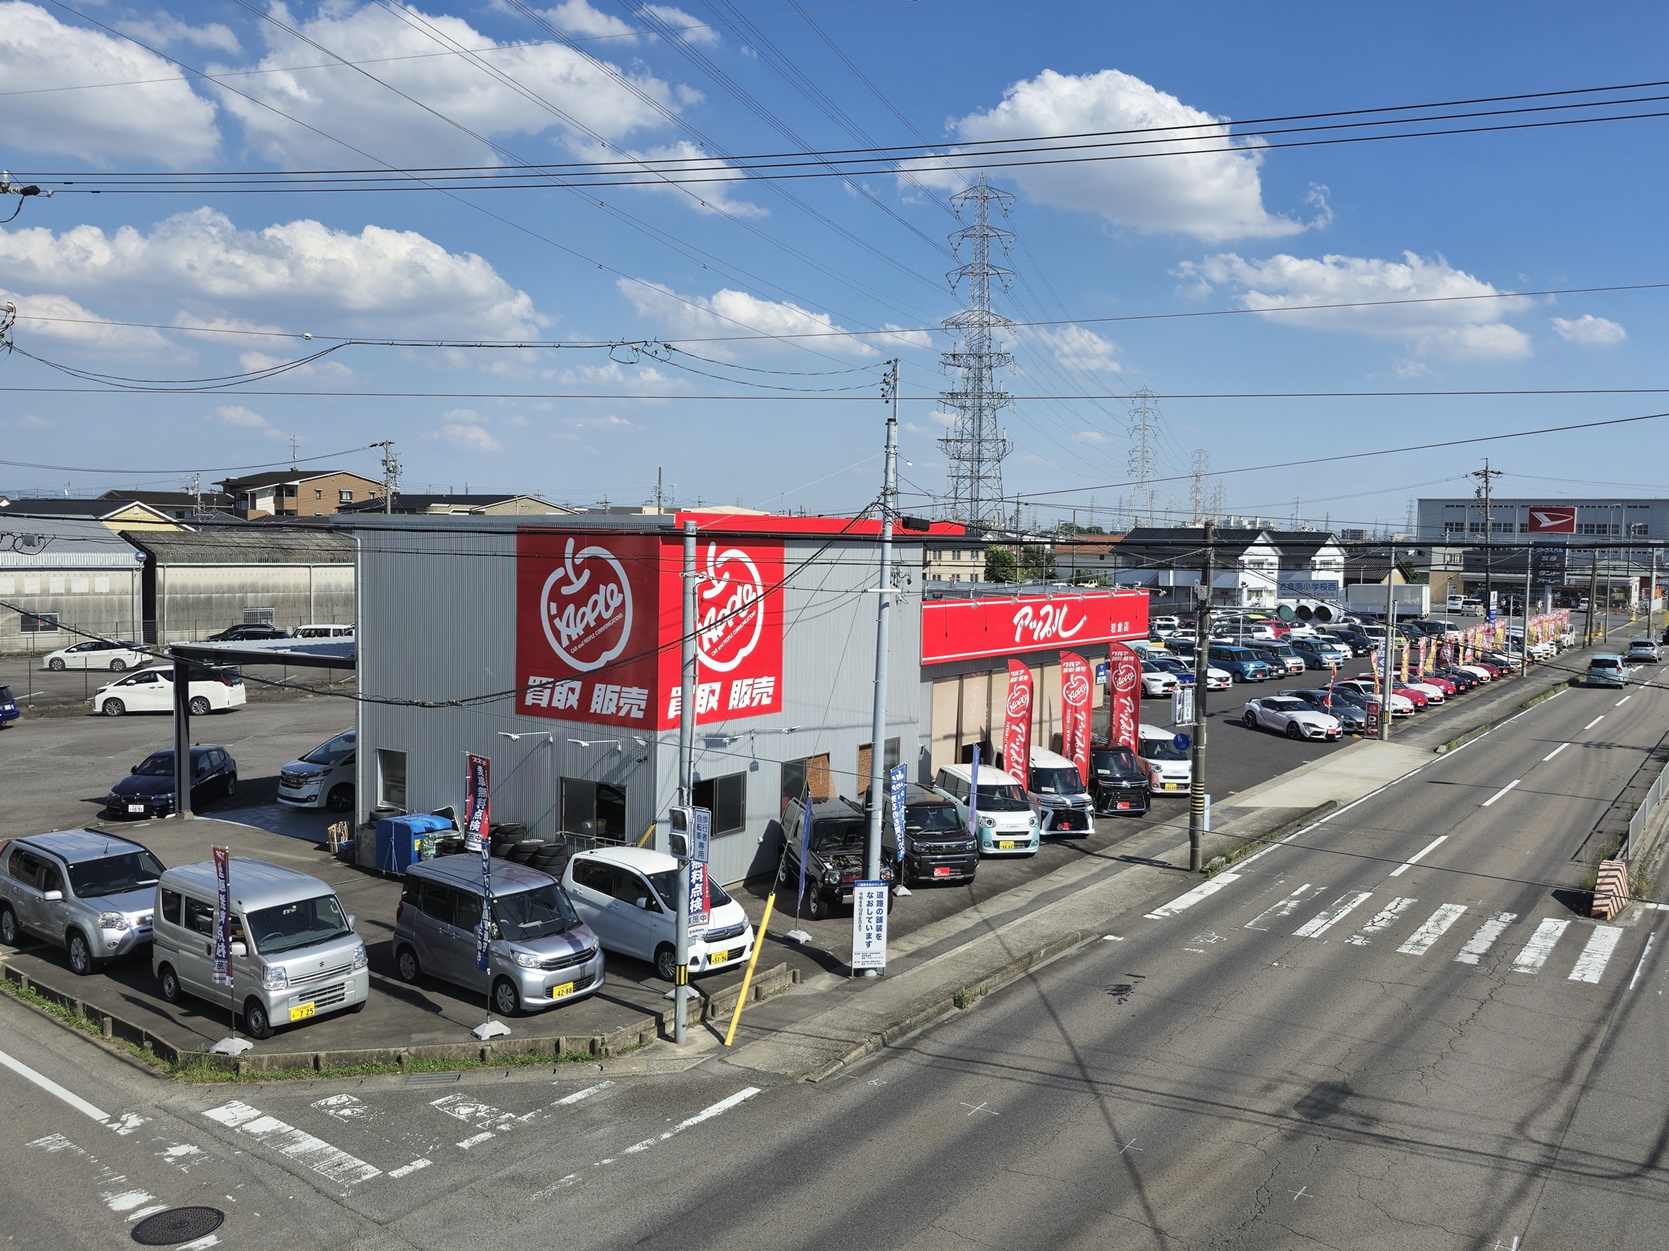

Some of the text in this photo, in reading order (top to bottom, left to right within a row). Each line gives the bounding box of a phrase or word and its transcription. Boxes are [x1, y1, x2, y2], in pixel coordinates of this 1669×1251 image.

[1013, 603, 1087, 643] アップル
[1110, 621, 1129, 633] 岩倉店
[728, 676, 775, 710] 販売
[1010, 669, 1024, 677] クルマ
[525, 675, 649, 719] 買取 販売
[865, 891, 874, 948] なおしています
[875, 891, 884, 941] 道路の舗装を
